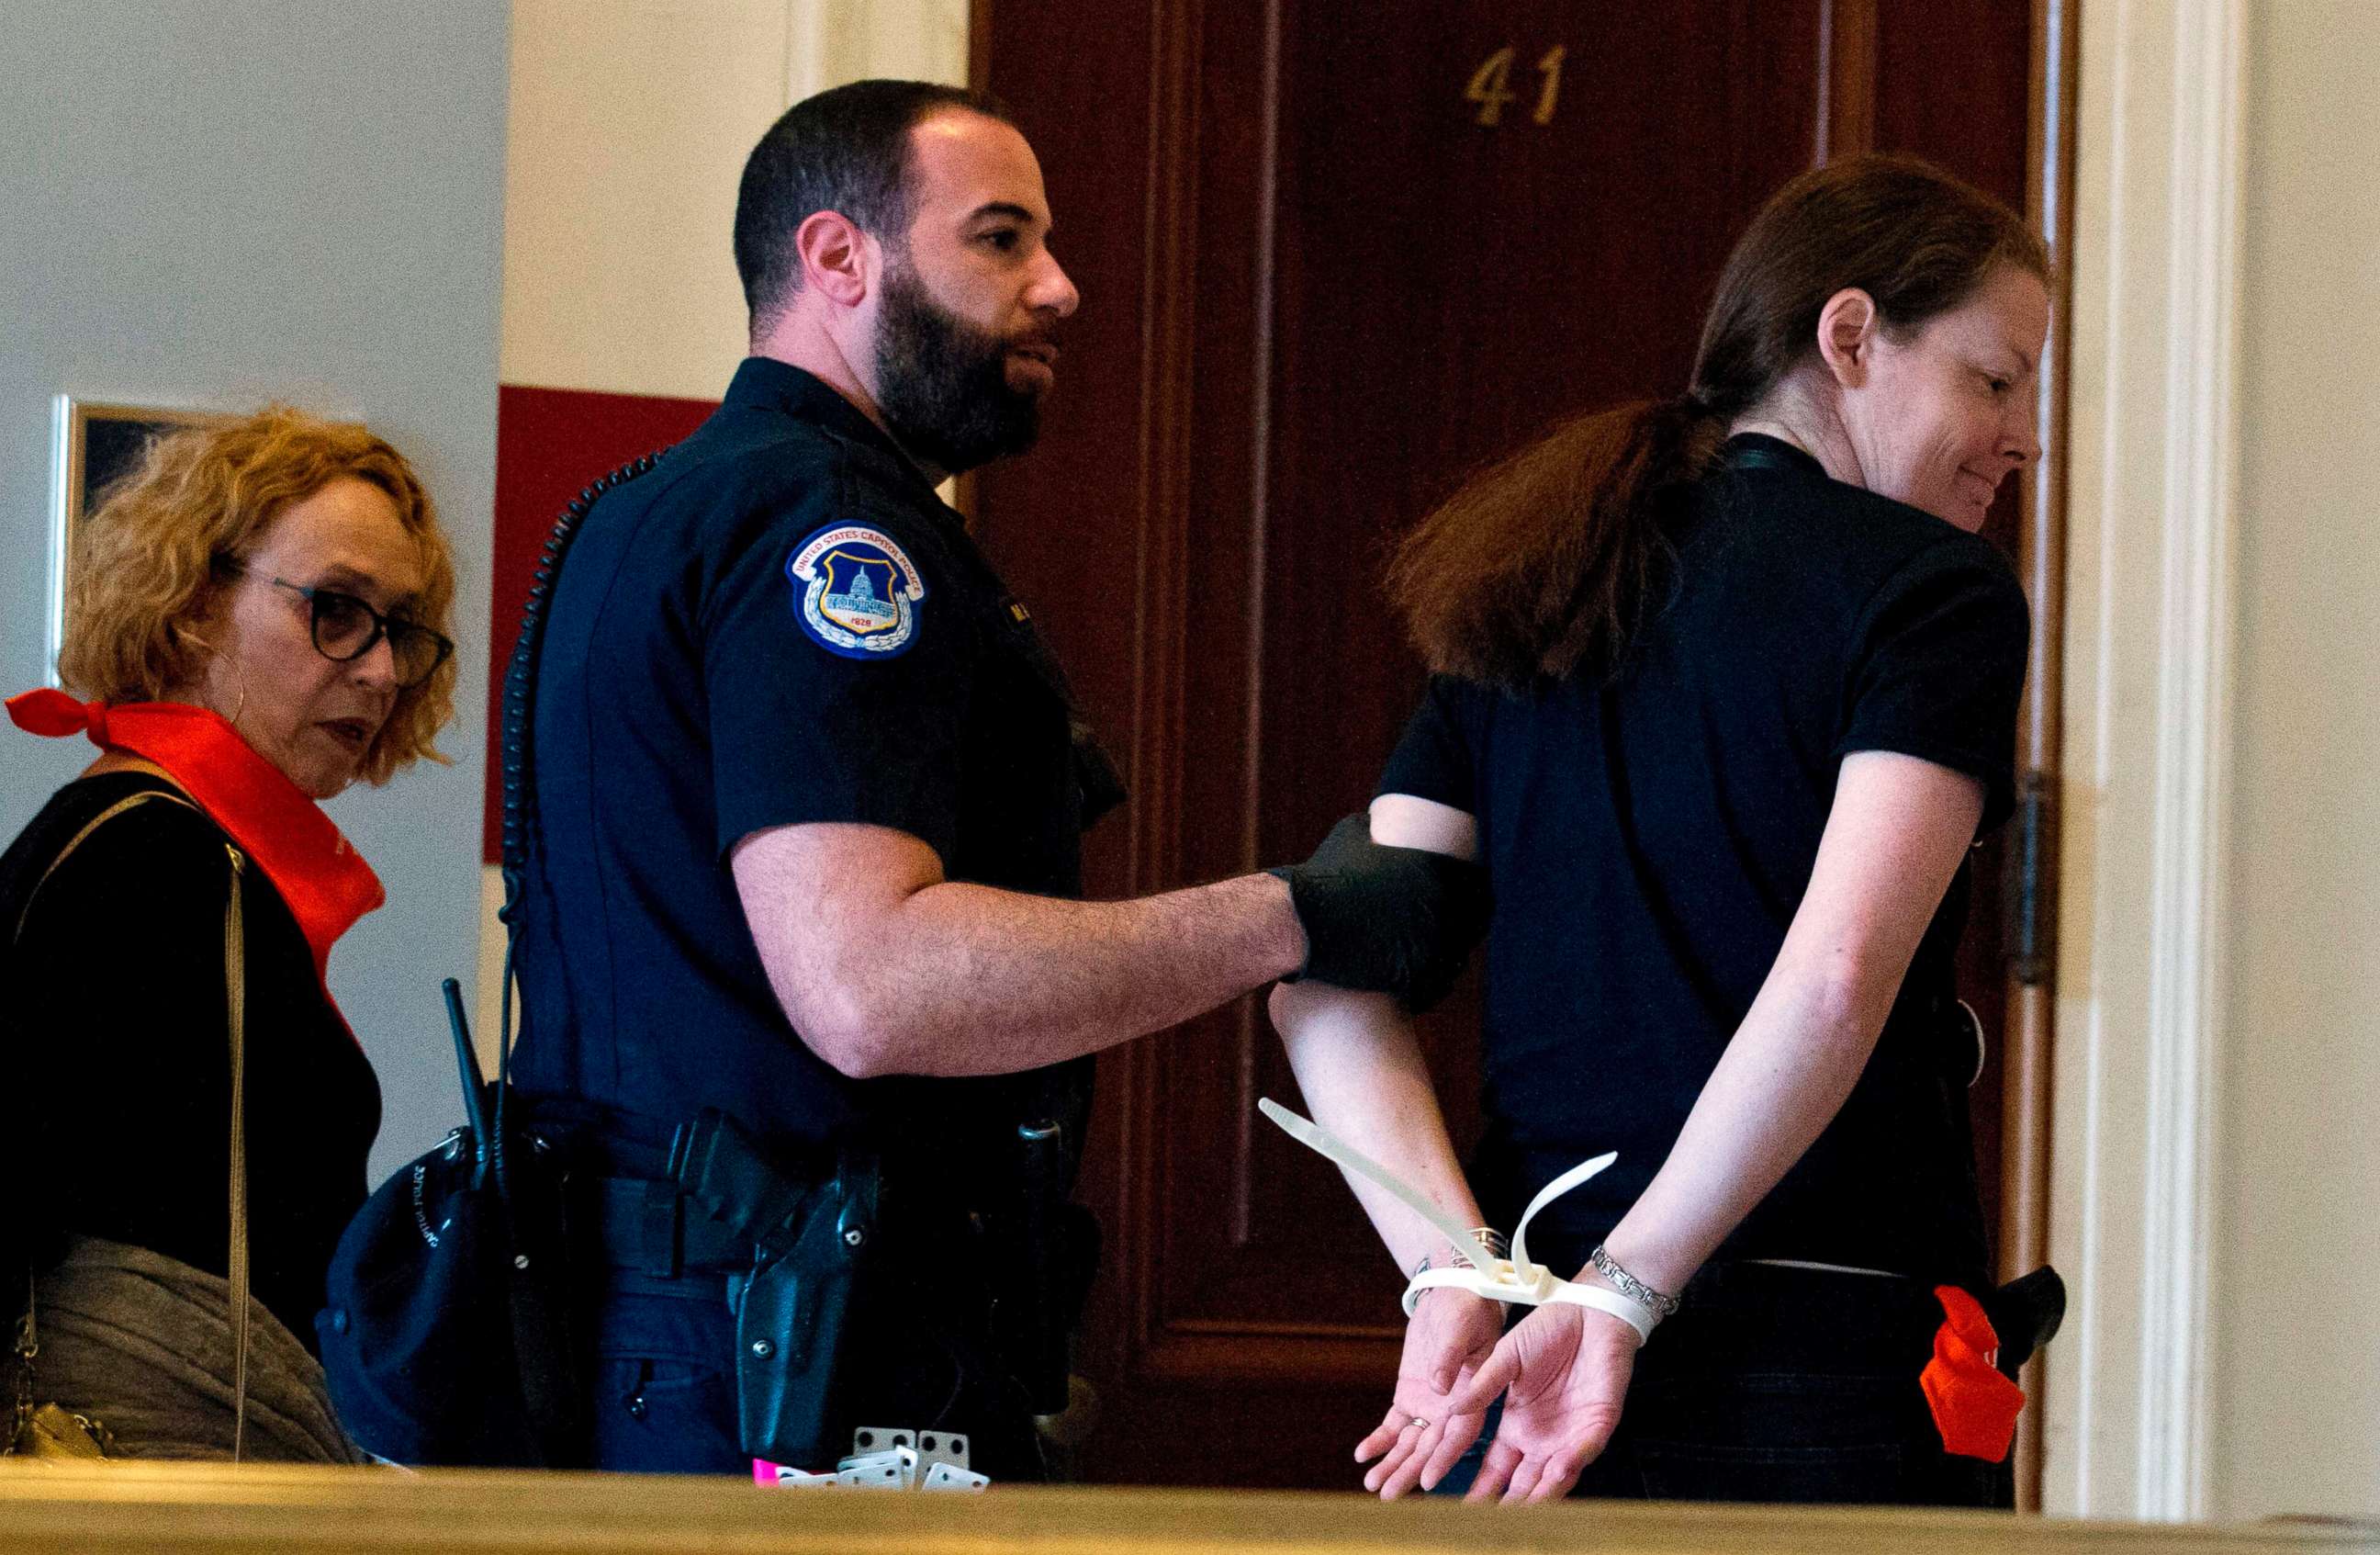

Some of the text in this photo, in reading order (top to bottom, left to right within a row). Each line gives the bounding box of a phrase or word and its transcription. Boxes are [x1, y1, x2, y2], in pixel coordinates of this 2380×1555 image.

[1464, 45, 1565, 126] 41
[796, 530, 920, 592] UNITED STATES CAPITOL POLICE
[851, 617, 871, 626] 1828
[413, 1166, 426, 1205] POLICE
